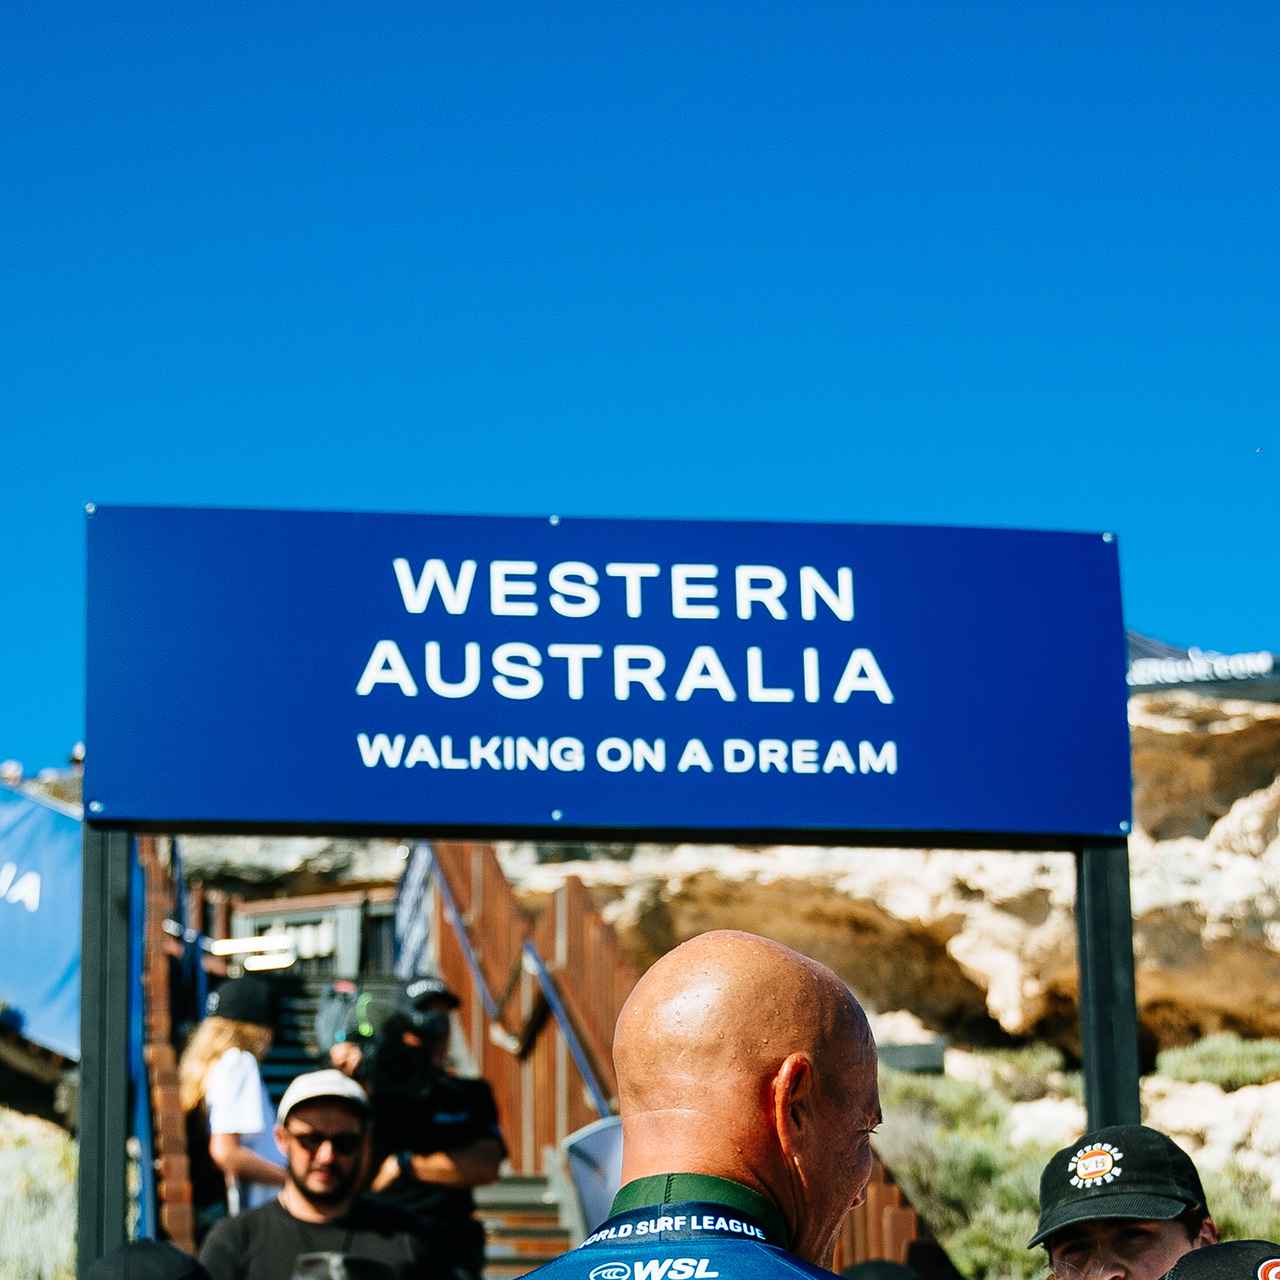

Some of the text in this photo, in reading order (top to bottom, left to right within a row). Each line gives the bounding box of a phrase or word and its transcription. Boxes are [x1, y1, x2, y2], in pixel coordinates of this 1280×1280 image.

[393, 558, 854, 621] WESTERN
[356, 640, 893, 704] AUSTRALIA
[357, 734, 897, 774] WALKING ON A DREAM
[635, 1215, 687, 1236] SURF
[691, 1215, 766, 1241] LEAGUE
